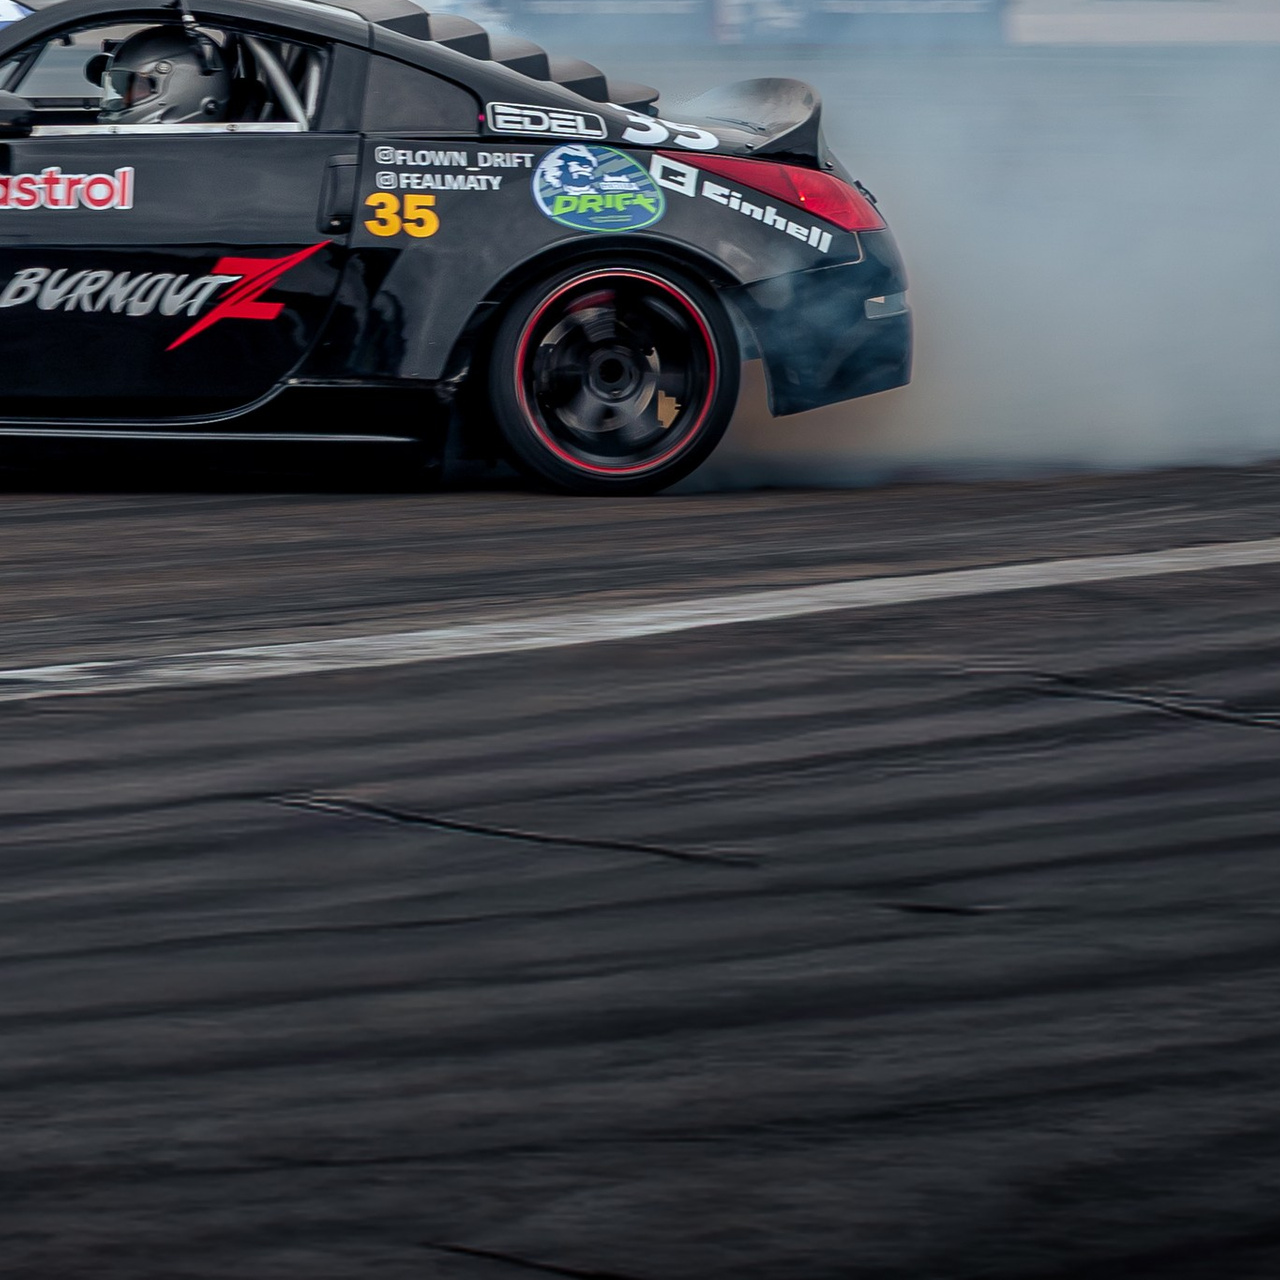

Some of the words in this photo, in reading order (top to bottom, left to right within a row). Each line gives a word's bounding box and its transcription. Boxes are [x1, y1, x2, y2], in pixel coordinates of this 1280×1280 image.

[494, 105, 603, 136] EDEL
[606, 102, 720, 151] 35
[364, 192, 440, 238] 35
[701, 180, 833, 254] Einhell
